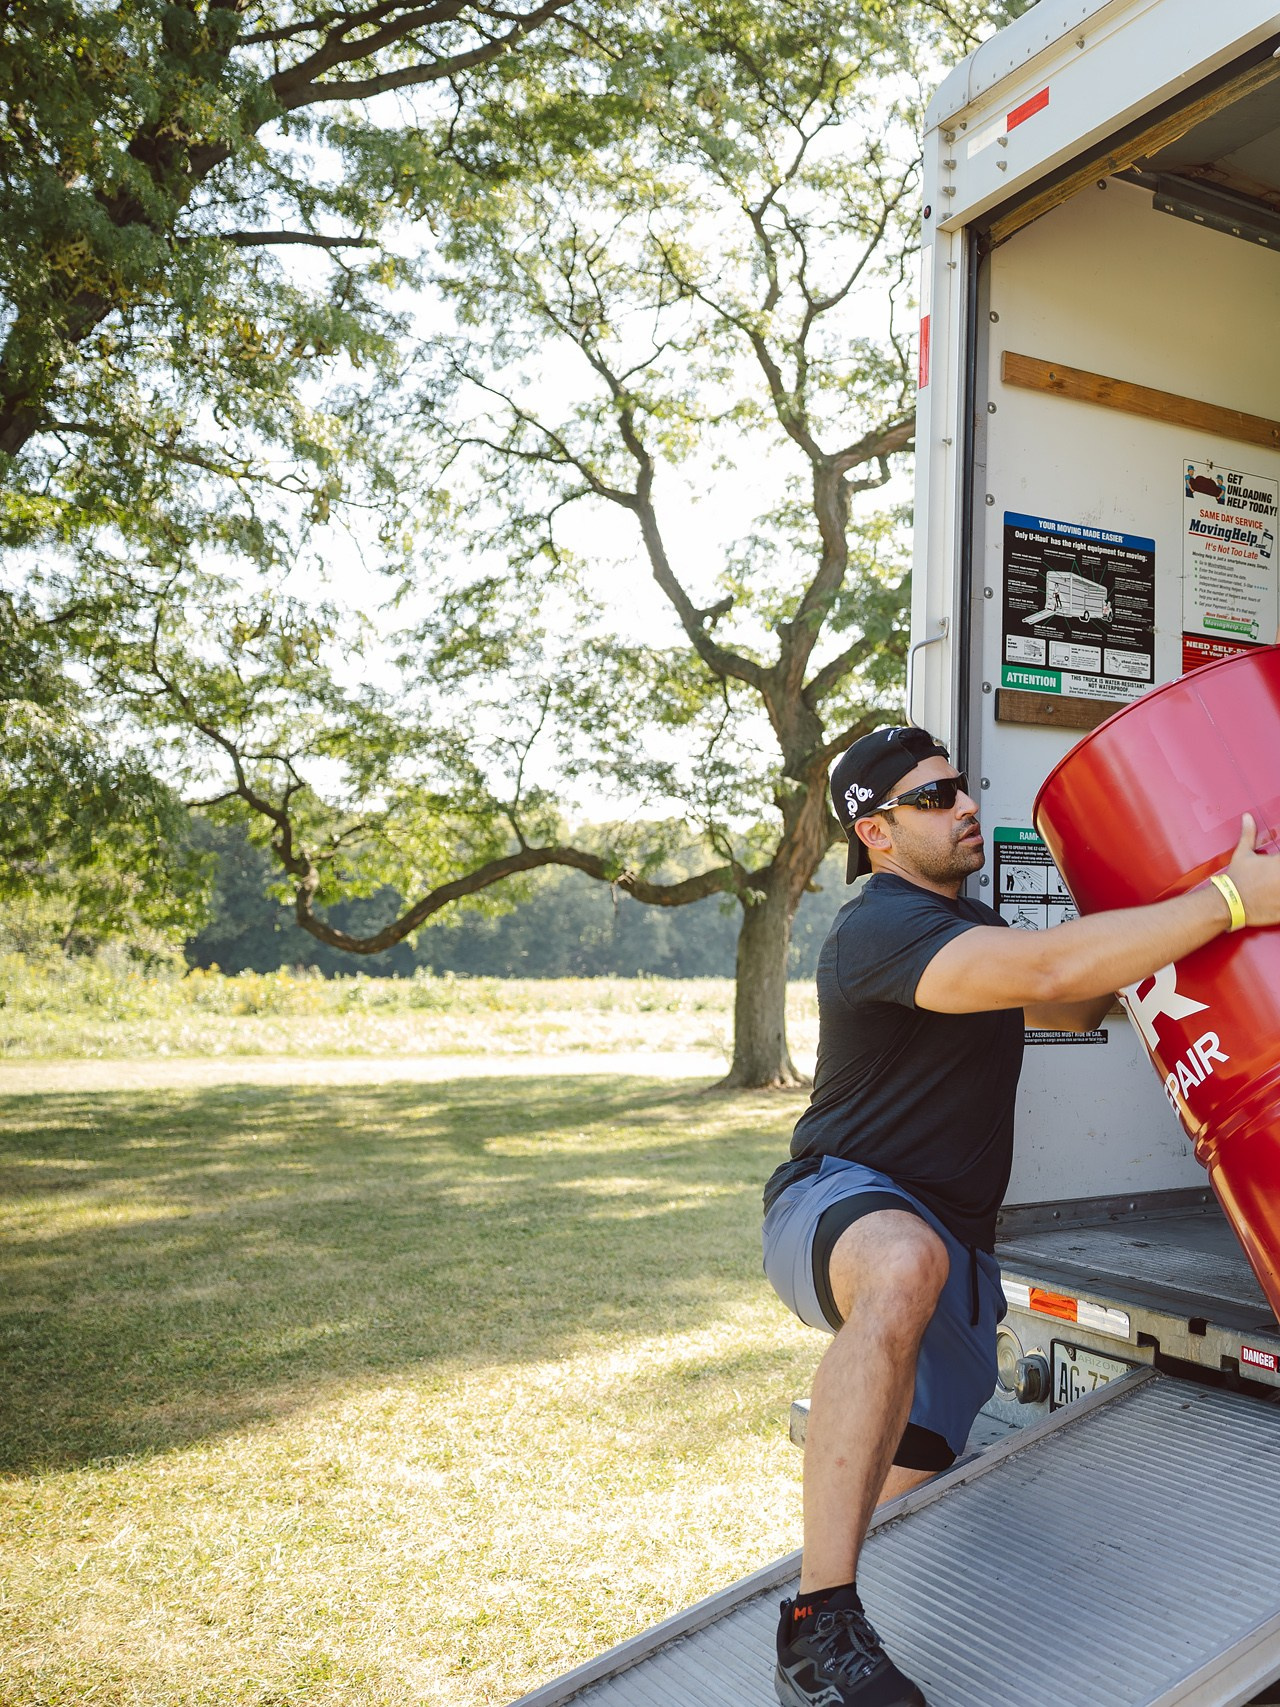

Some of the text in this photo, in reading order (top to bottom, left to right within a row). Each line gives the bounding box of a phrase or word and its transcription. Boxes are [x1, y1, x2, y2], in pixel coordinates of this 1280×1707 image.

[1227, 473, 1243, 486] GET
[1227, 484, 1272, 504] UNLOADING
[1226, 496, 1278, 516] HELP TODAY!
[1200, 509, 1263, 530] SAME DAY SERVICE
[1039, 520, 1123, 543] YOUR MOVING MADE EASIER
[1015, 530, 1028, 541] Only
[1029, 533, 1048, 544] U-Haul
[1050, 537, 1061, 546] has
[1062, 539, 1072, 548] the
[1073, 541, 1086, 551] right
[1087, 544, 1116, 556] equipment
[1117, 549, 1126, 558] for
[1205, 542, 1258, 560] It's Not Too Late
[1186, 641, 1210, 650] NEED
[1006, 672, 1057, 688] ATTENTION
[1098, 684, 1130, 692] WATERPROOF.
[1104, 678, 1147, 690] WATER-RESISTANT,
[1078, 1355, 1125, 1373] ARIZONA
[1243, 1347, 1274, 1368] DANGER
